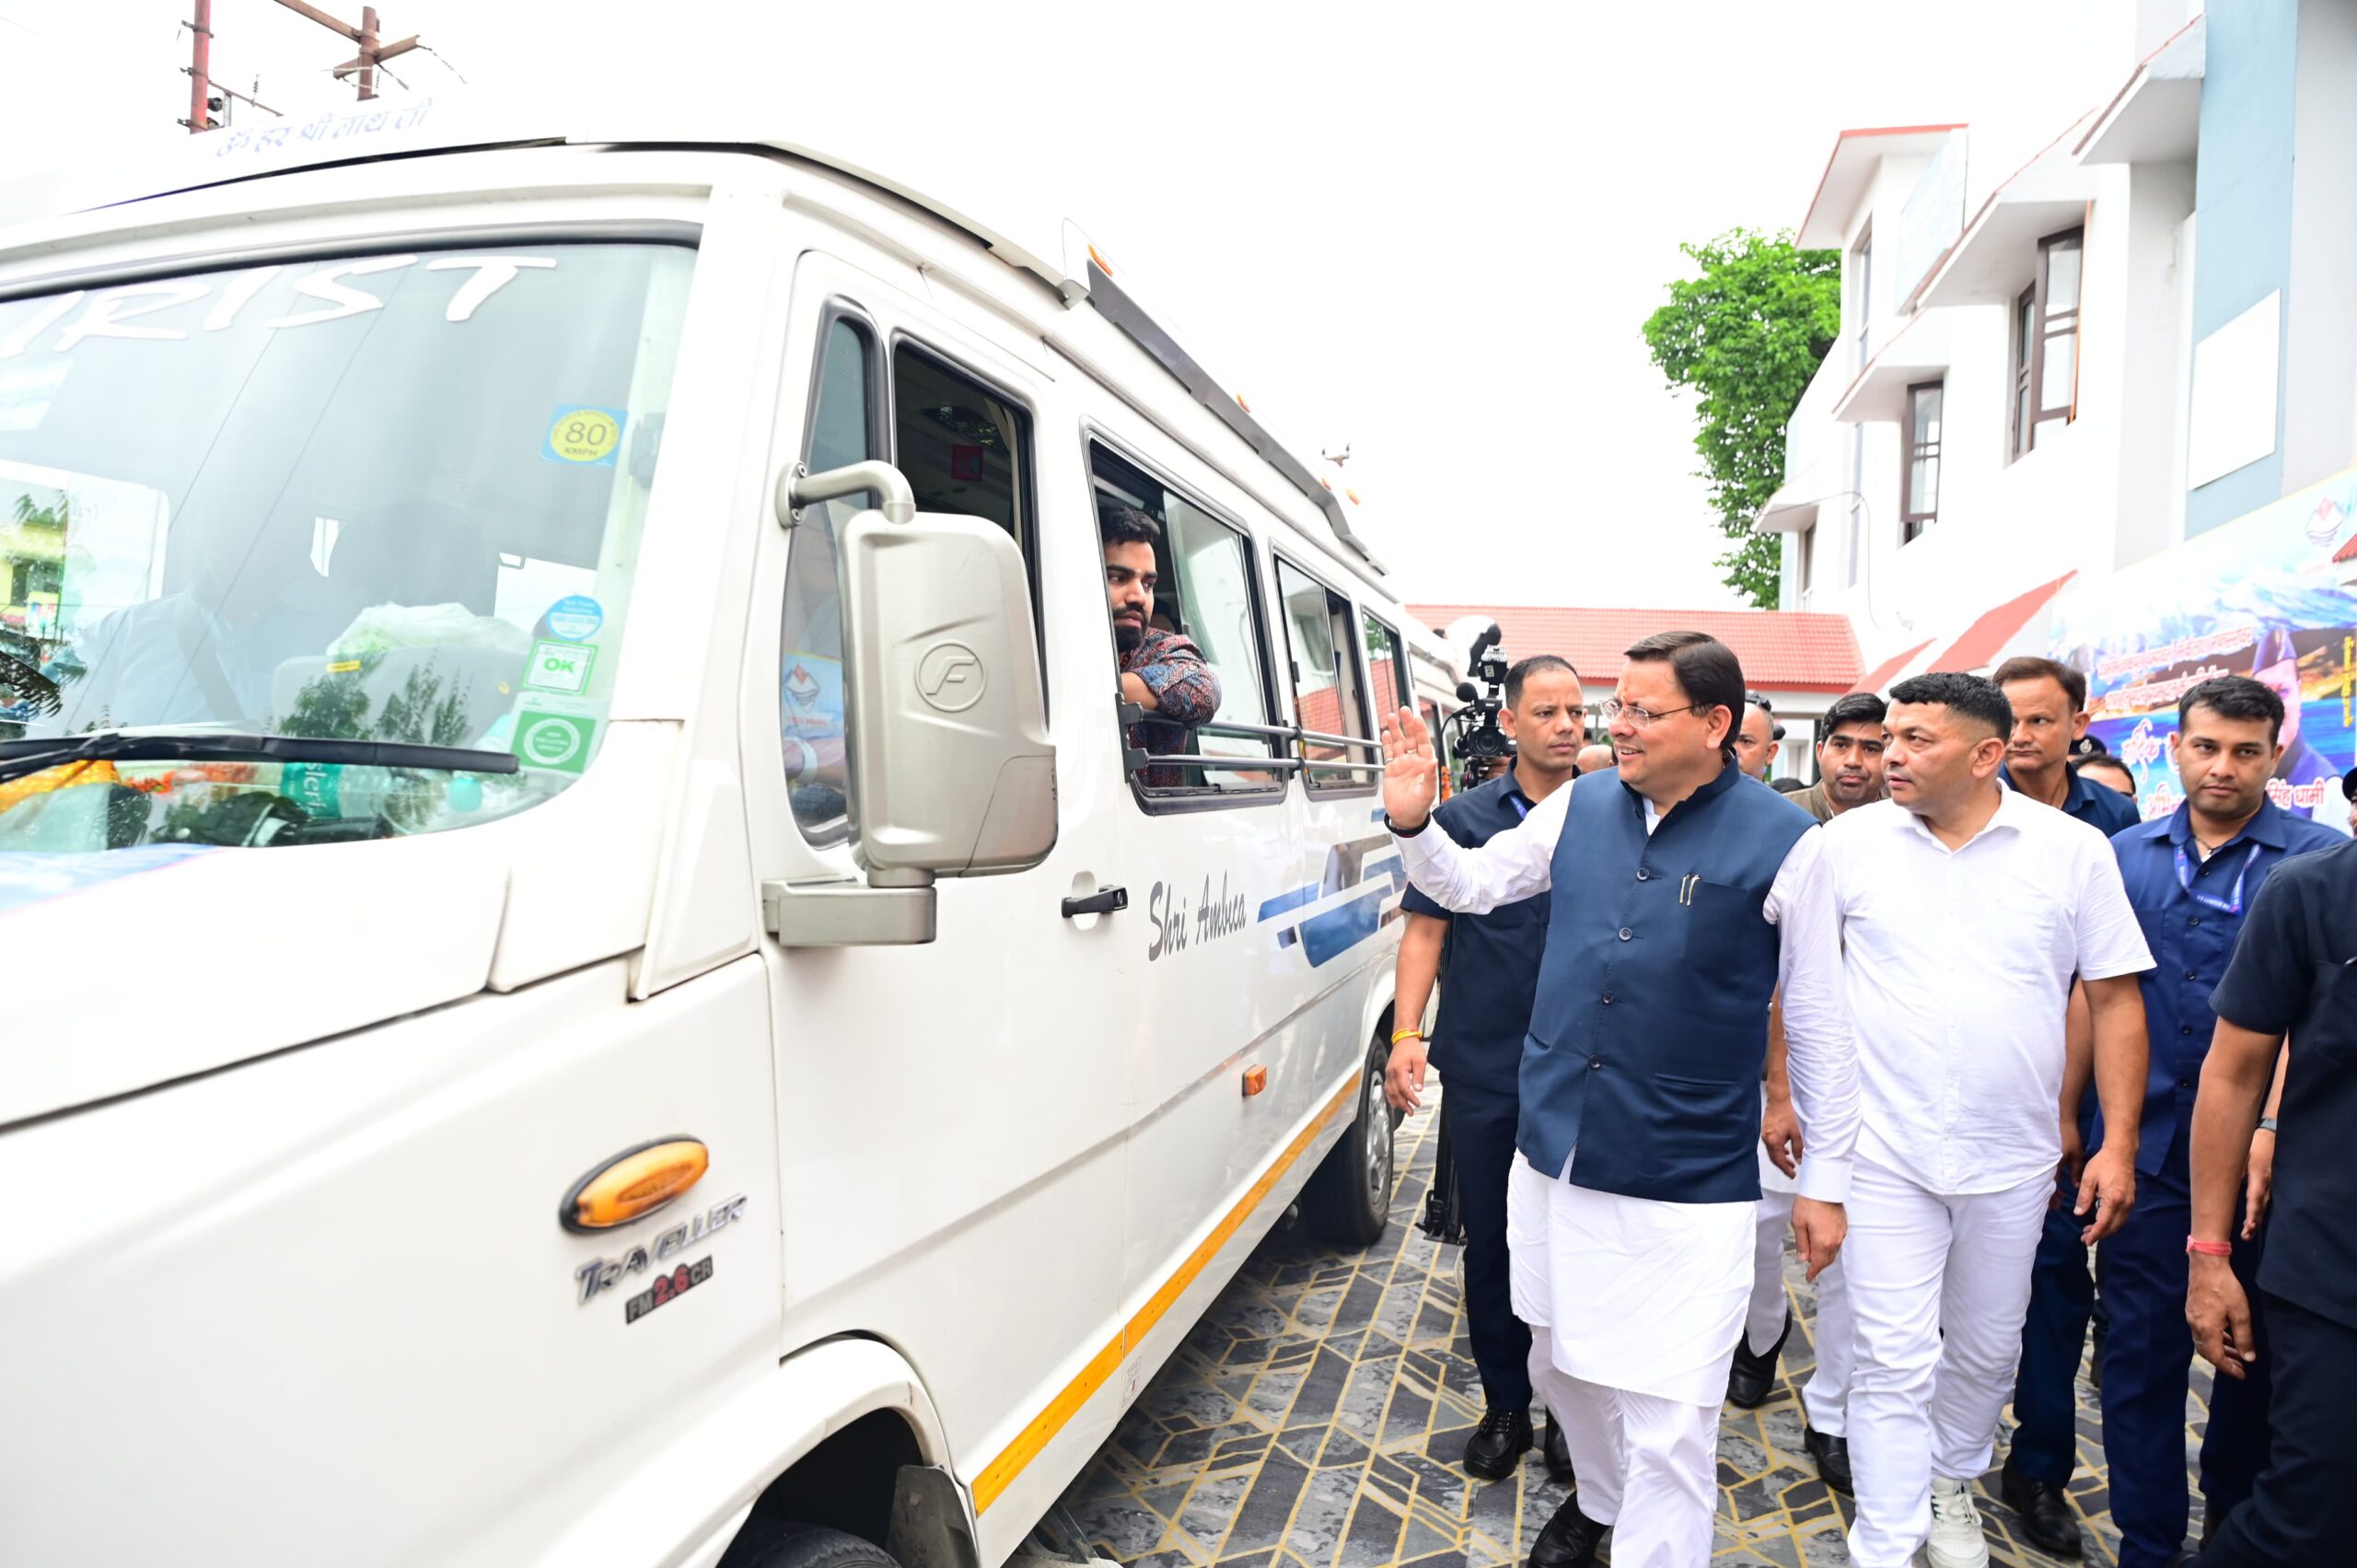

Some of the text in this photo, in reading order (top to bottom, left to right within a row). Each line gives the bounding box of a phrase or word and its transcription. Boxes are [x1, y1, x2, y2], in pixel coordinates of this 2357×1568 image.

[565, 422, 607, 446] 80
[544, 657, 576, 675] OK
[2294, 779, 2327, 806] धामी
[1149, 880, 1188, 961] Shri
[575, 1194, 748, 1306] TRAVELLER
